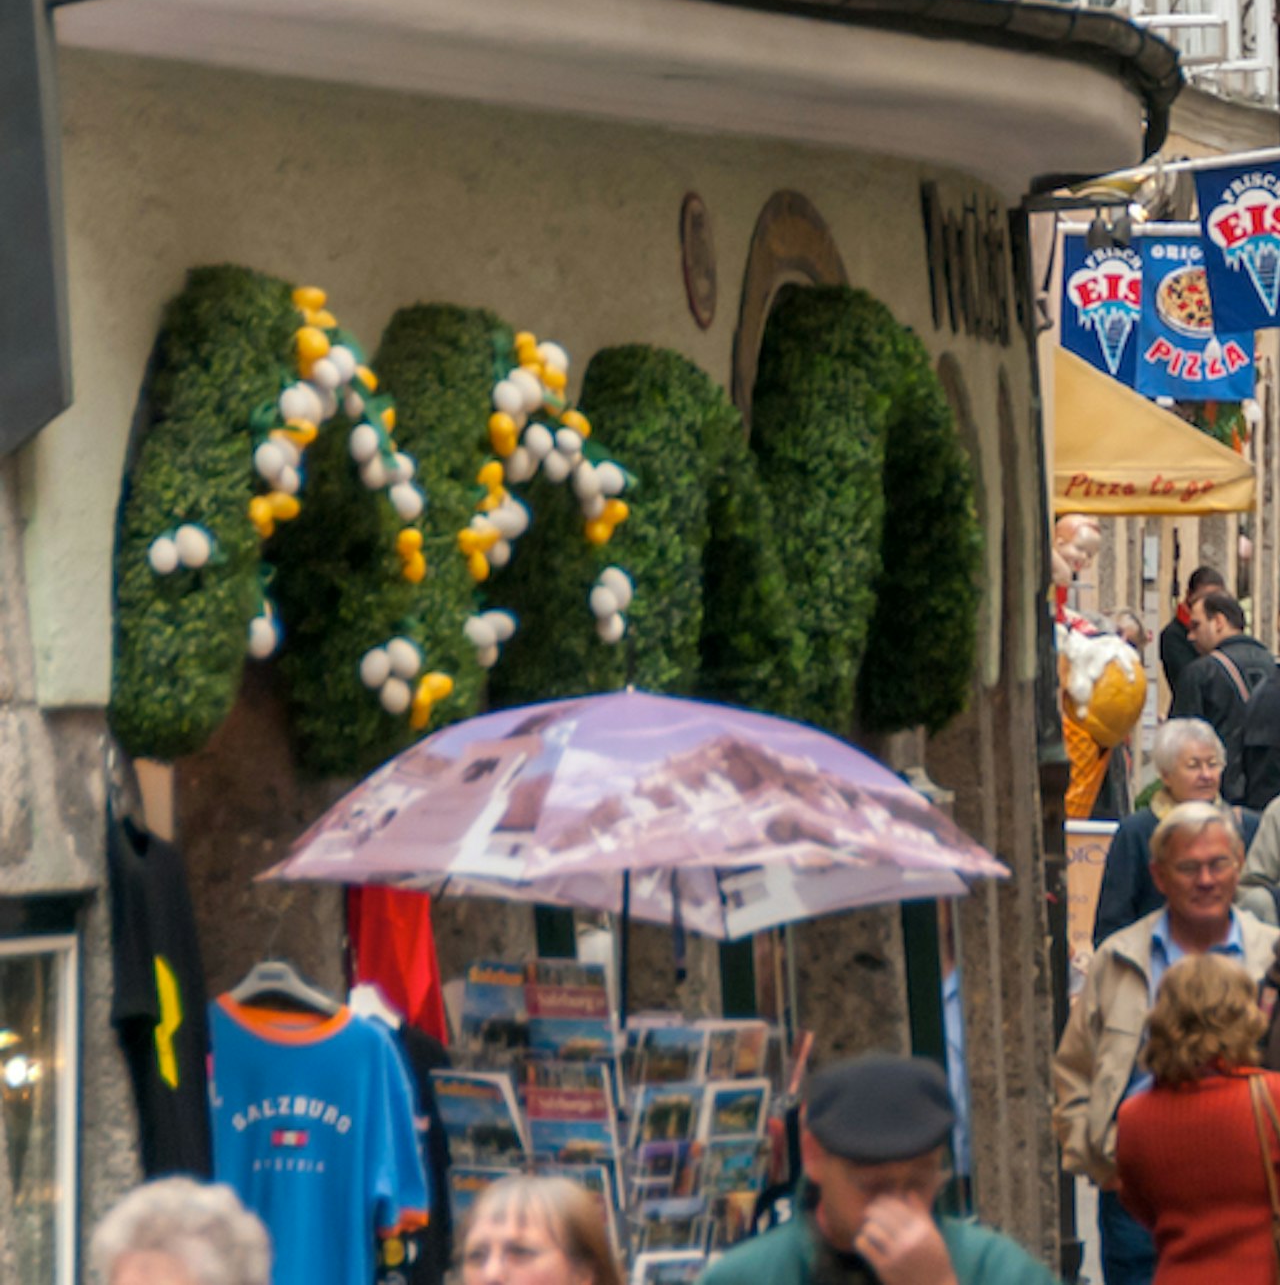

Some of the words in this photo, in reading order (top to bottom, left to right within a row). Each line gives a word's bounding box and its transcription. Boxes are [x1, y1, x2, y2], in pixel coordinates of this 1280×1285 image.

[1150, 243, 1203, 261] ORIG
[1064, 472, 1137, 498] Pizza
[1149, 474, 1175, 496] to
[1179, 479, 1215, 503] go
